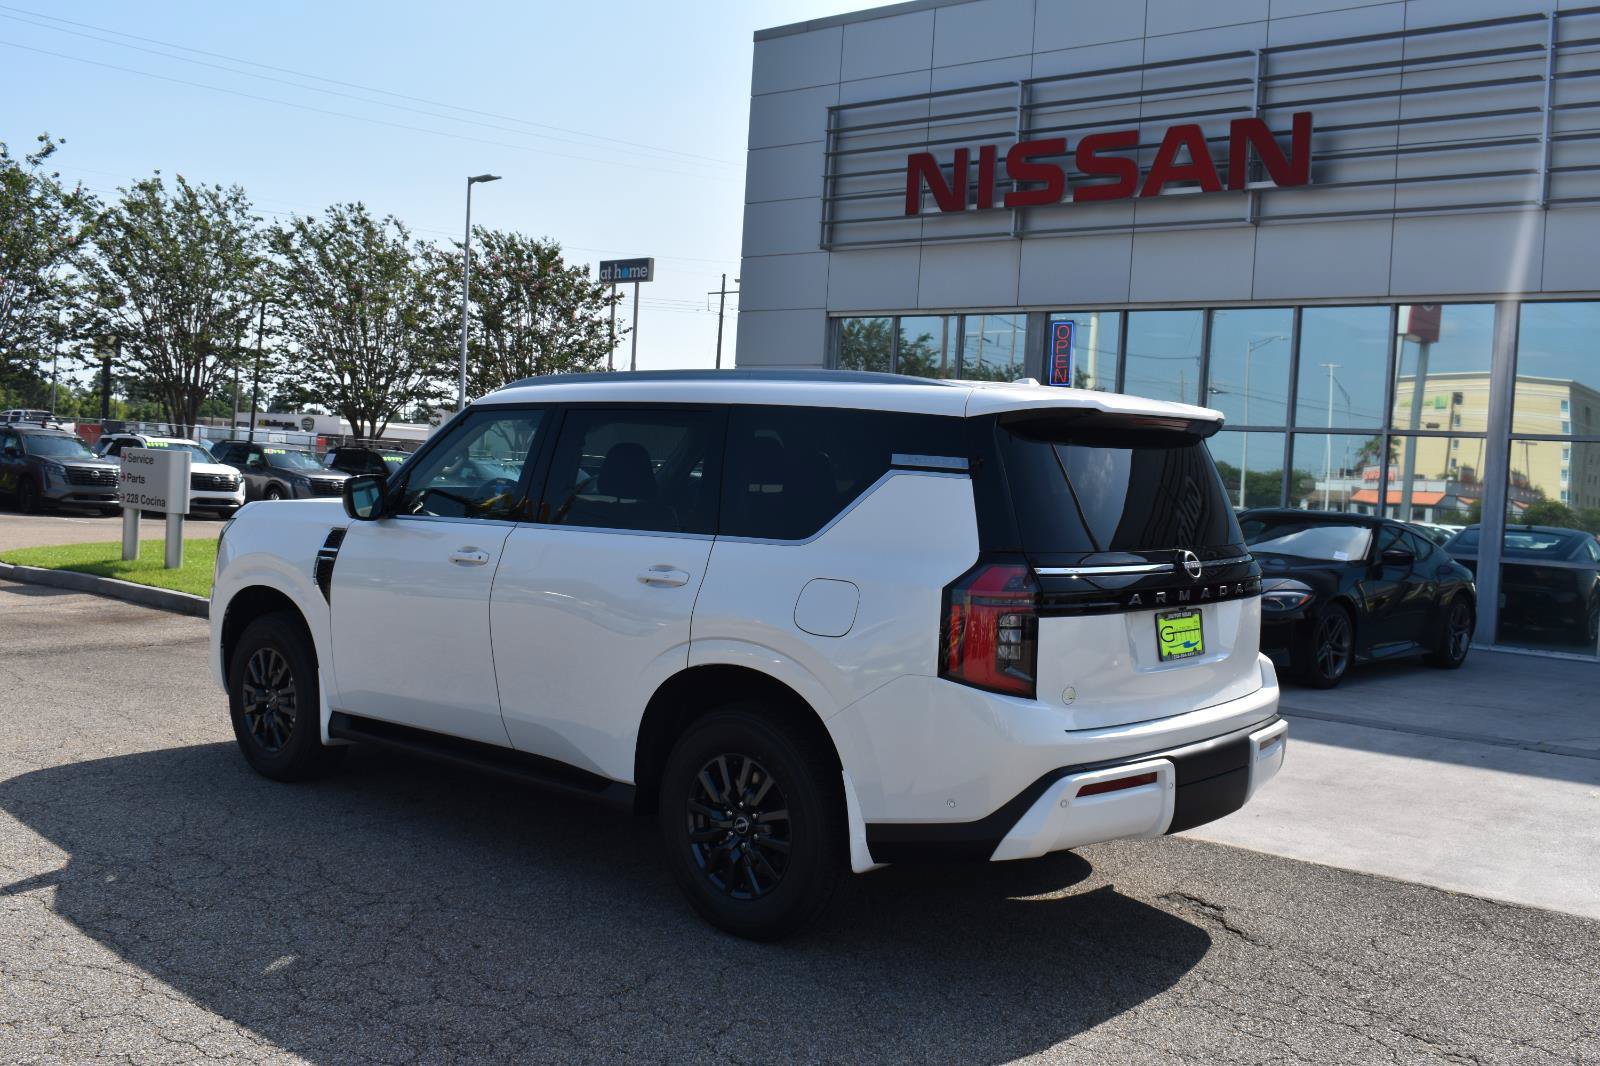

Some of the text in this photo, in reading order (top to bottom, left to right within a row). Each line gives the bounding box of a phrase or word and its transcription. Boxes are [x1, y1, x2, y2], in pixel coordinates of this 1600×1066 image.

[905, 111, 1312, 216] NISSAN
[600, 264, 647, 280] at home
[1055, 325, 1070, 383] OPEN
[128, 453, 154, 464] Service
[127, 473, 145, 484] Parts
[126, 493, 166, 507] 228 Cocina
[1128, 583, 1244, 605] ARMADA
